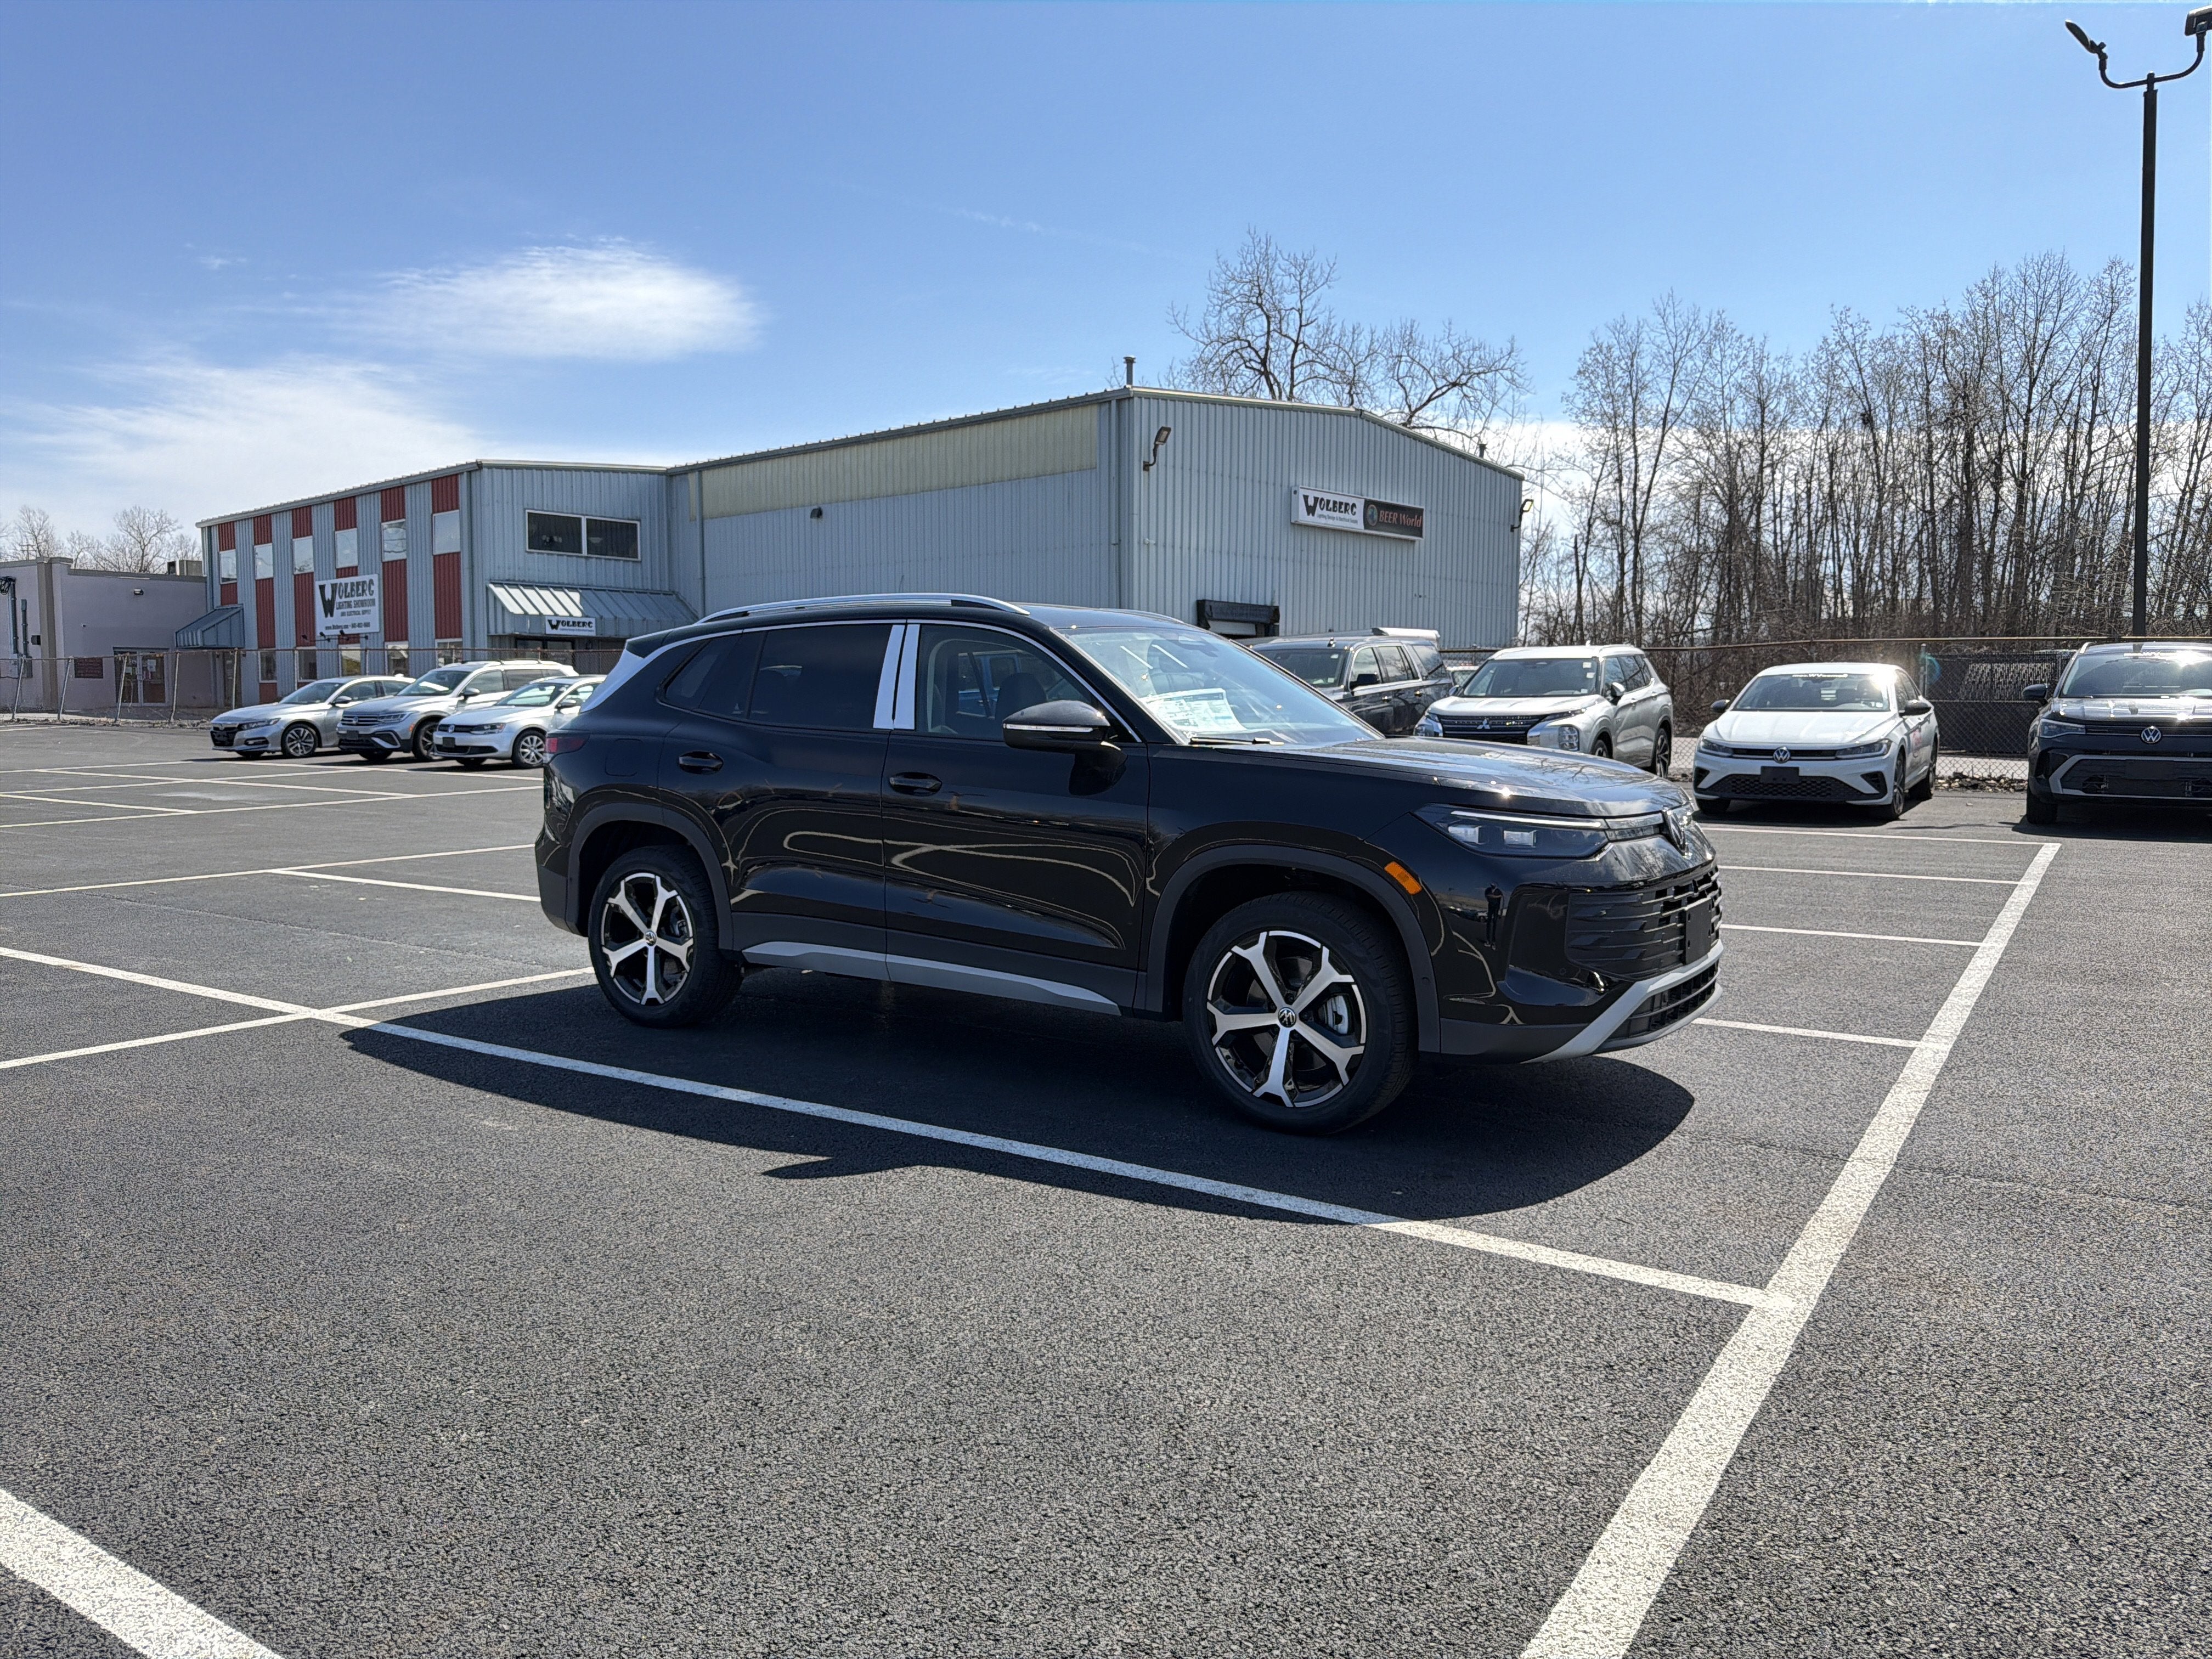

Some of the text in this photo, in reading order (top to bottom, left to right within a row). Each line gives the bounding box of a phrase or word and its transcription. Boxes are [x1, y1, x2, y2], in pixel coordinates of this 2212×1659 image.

[1303, 494, 1357, 517] WOLBERG
[1379, 510, 1422, 527] BEER World
[319, 578, 375, 618] WOLBERG
[548, 619, 592, 630] WOLBERG
